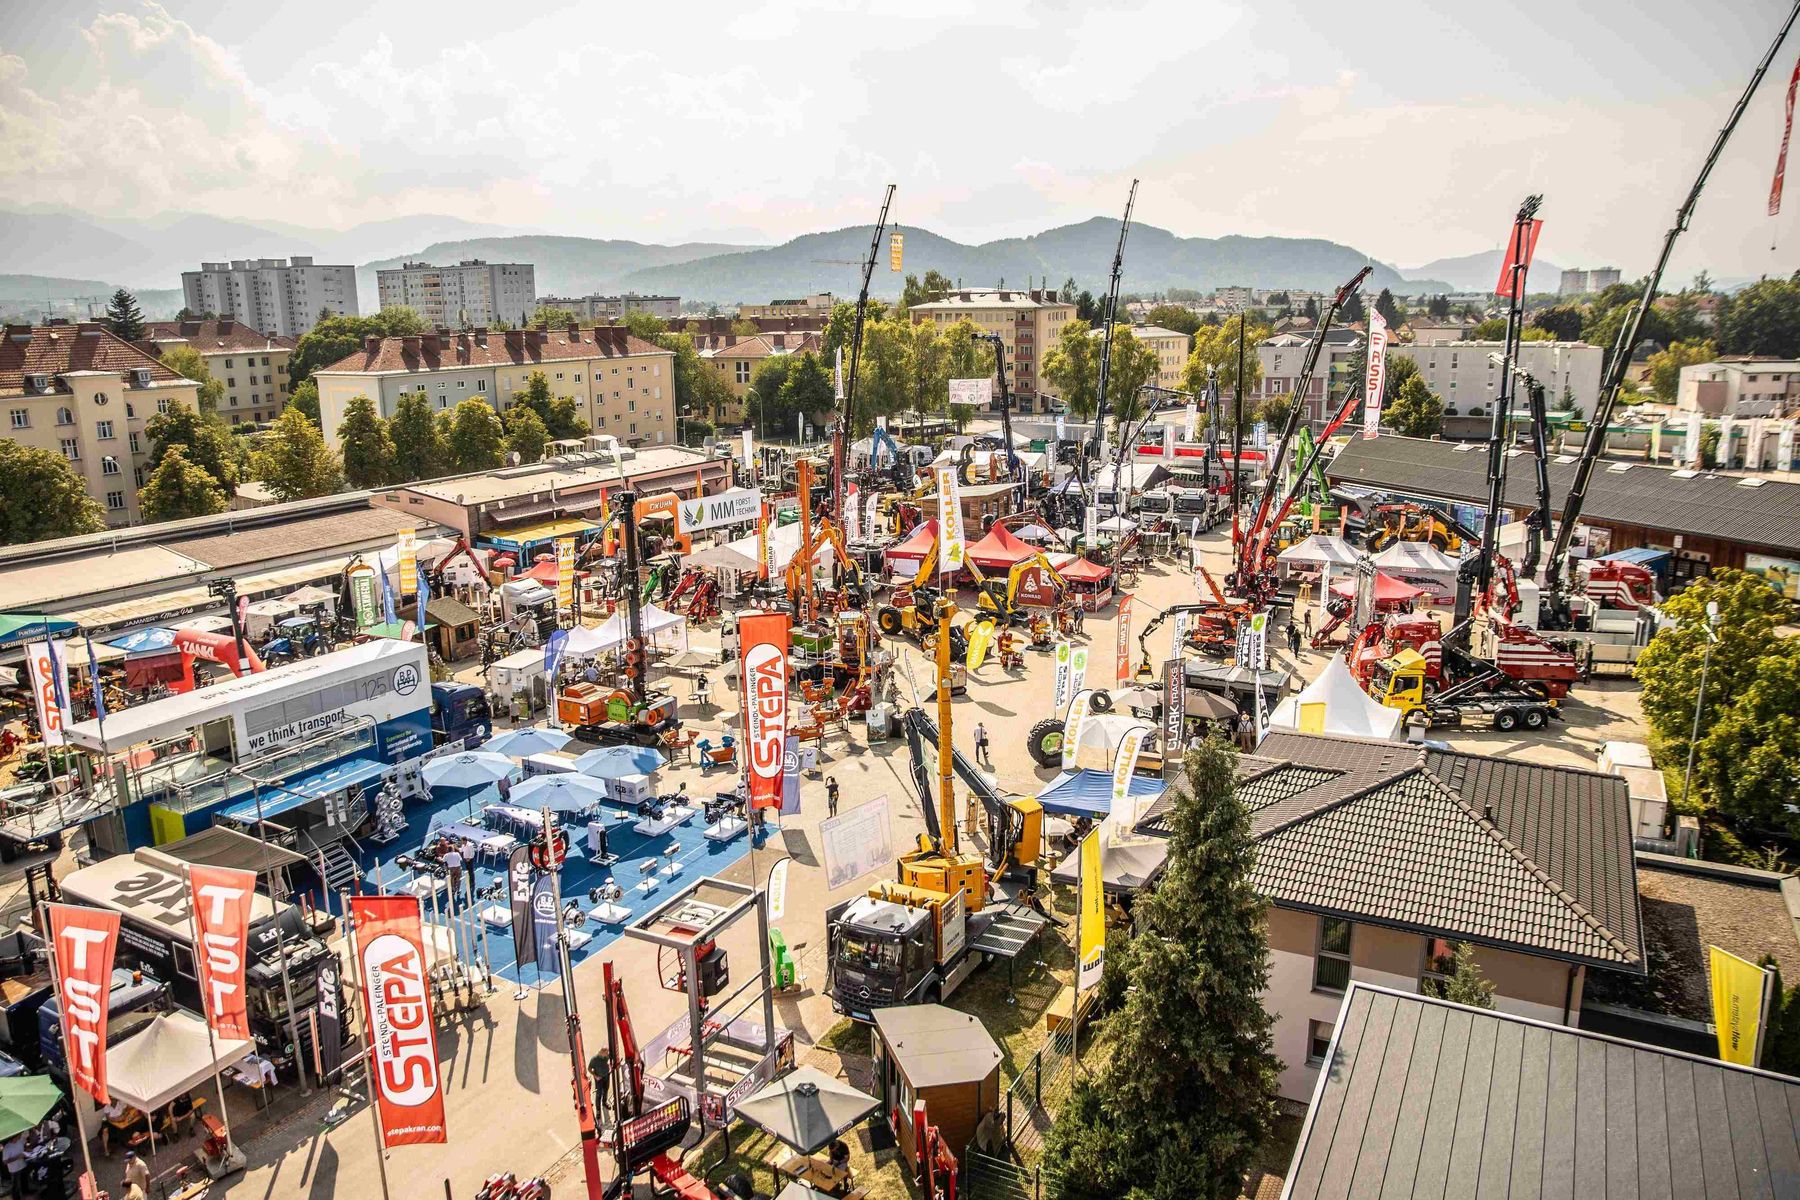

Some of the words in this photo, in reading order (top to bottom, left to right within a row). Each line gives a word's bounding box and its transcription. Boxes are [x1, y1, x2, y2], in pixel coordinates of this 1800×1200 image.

[1367, 334, 1383, 405] FASSI
[711, 500, 735, 521] MM
[735, 497, 752, 507] FORST
[736, 506, 758, 516] TECHNIK
[943, 472, 954, 541] KOLLER
[1120, 616, 1128, 653] FASSI
[362, 676, 387, 702] 125
[749, 667, 760, 739] STEINDL-PALFINGER
[753, 654, 783, 768] STEPA
[249, 735, 265, 750] we
[267, 724, 296, 744] think
[298, 708, 346, 733] transport
[1066, 698, 1086, 745] KOLLER
[1167, 705, 1179, 751] CLARK
[1116, 735, 1138, 785] KOLLER
[198, 885, 245, 1016] TST
[1083, 950, 1103, 972] wol
[60, 925, 109, 1069] TST
[317, 968, 338, 1020] ExTe
[371, 966, 392, 1057] STEINDL-PALFINGER
[380, 950, 434, 1093] STEPA
[727, 1075, 754, 1105] STEPA
[387, 1124, 443, 1136] stepakran.com
